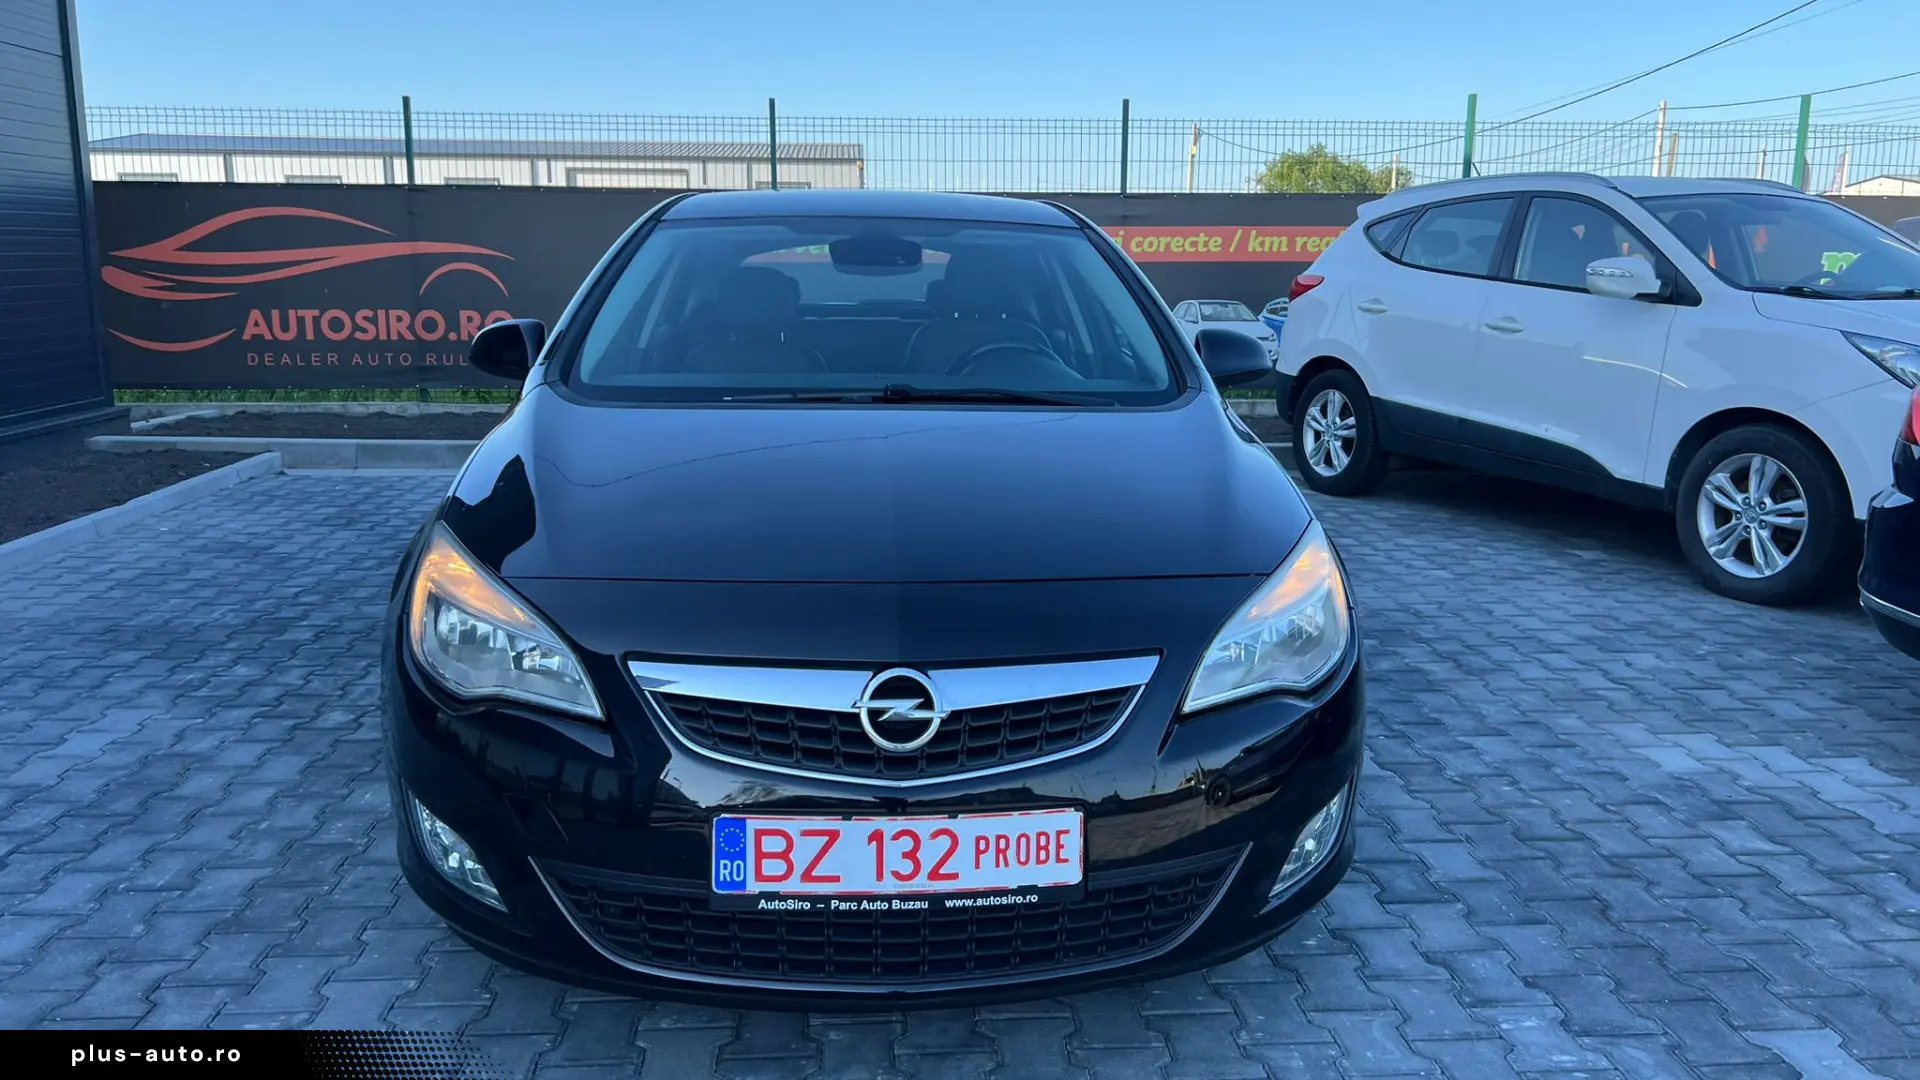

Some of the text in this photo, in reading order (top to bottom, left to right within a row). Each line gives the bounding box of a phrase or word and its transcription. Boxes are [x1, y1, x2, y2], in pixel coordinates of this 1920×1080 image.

[1130, 232, 1222, 252] corecte
[1248, 231, 1288, 252] km
[247, 353, 470, 366] DEALER AUTO RUL
[719, 828, 1071, 883] RO BZ 132 PROBE
[758, 898, 811, 910] AutoSiro
[831, 899, 860, 910] Parc
[861, 899, 889, 910] Auto
[892, 898, 929, 910] Buzau
[945, 893, 1038, 908] www.autosiro.ro
